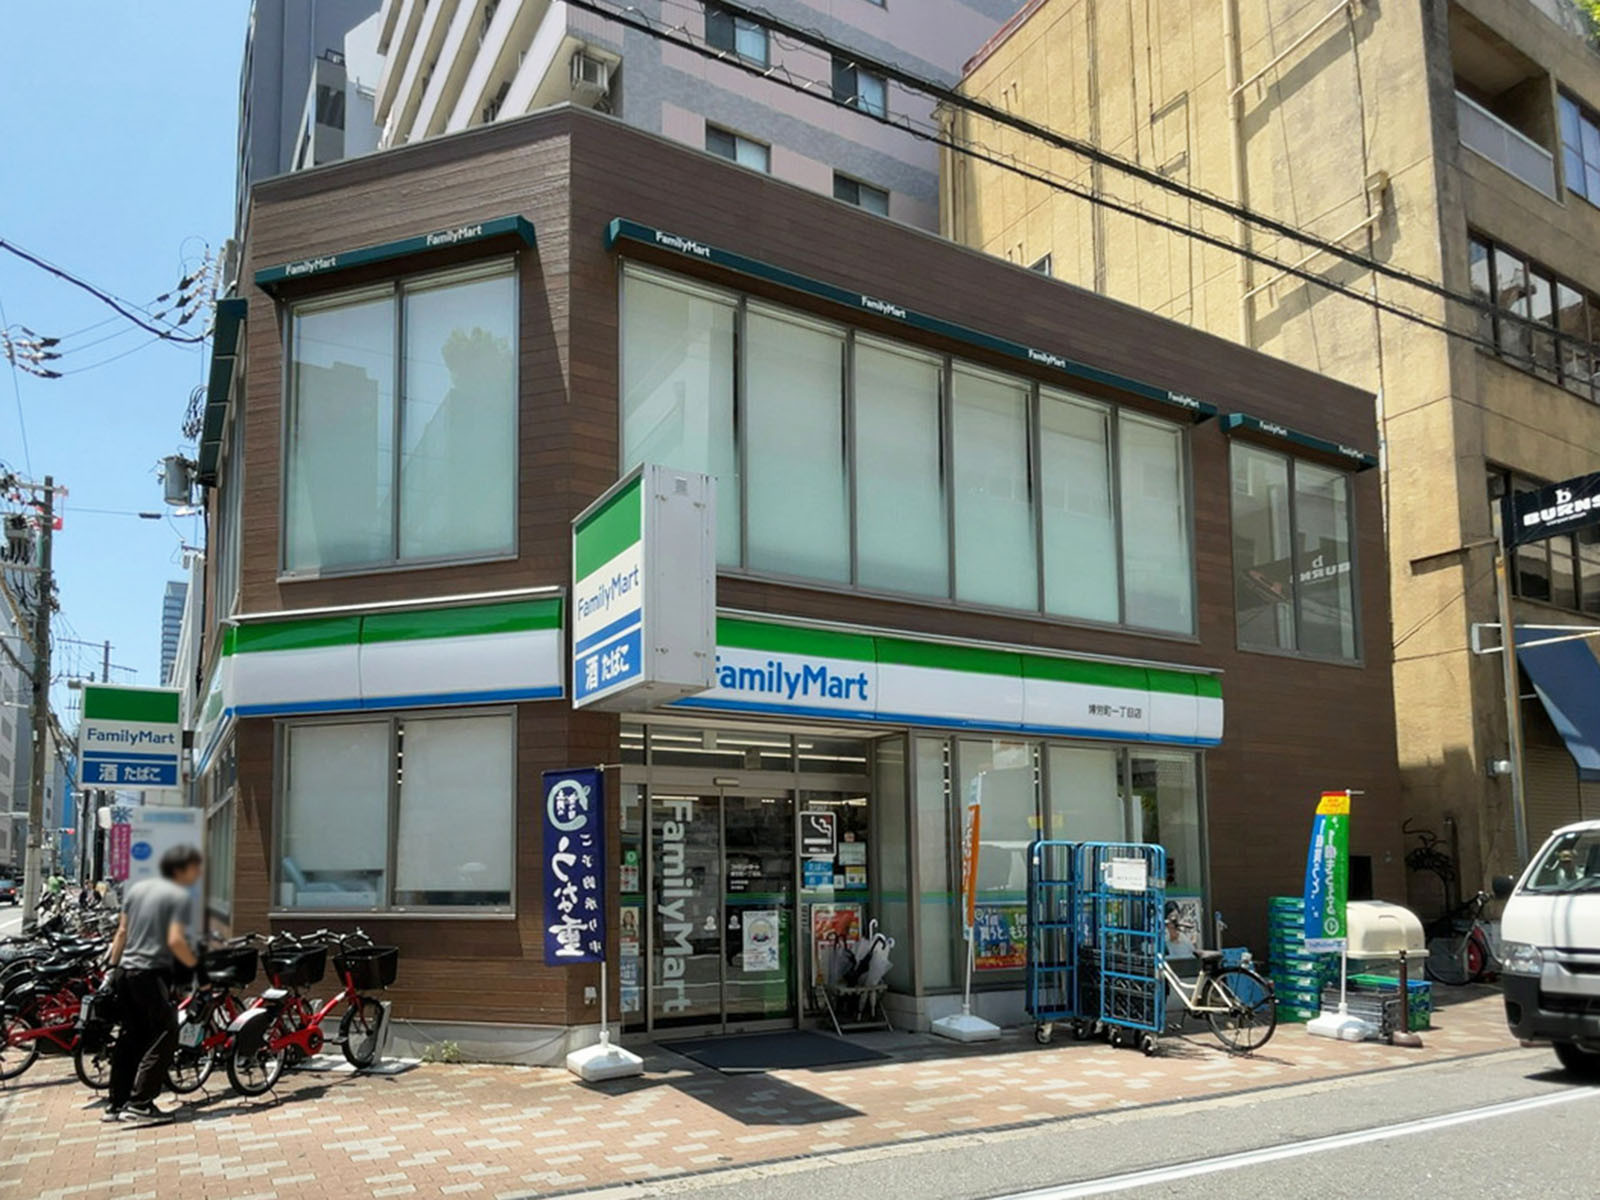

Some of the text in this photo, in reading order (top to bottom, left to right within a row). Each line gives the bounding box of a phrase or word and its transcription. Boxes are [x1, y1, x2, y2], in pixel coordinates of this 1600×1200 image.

[426, 226, 482, 246] FamilyMart
[655, 231, 710, 258] FamilyMart
[285, 257, 336, 276] FamilyMart
[861, 295, 907, 319] FamilyMart
[1028, 349, 1066, 369] FamilyMart
[577, 564, 640, 621] FamilyMart
[585, 644, 630, 691] 酒 たばこ
[716, 656, 868, 701] amilyMart
[87, 728, 175, 746] FamilyMart
[98, 764, 162, 782] 酒 たばこ
[657, 800, 694, 1013] FamilyMart
